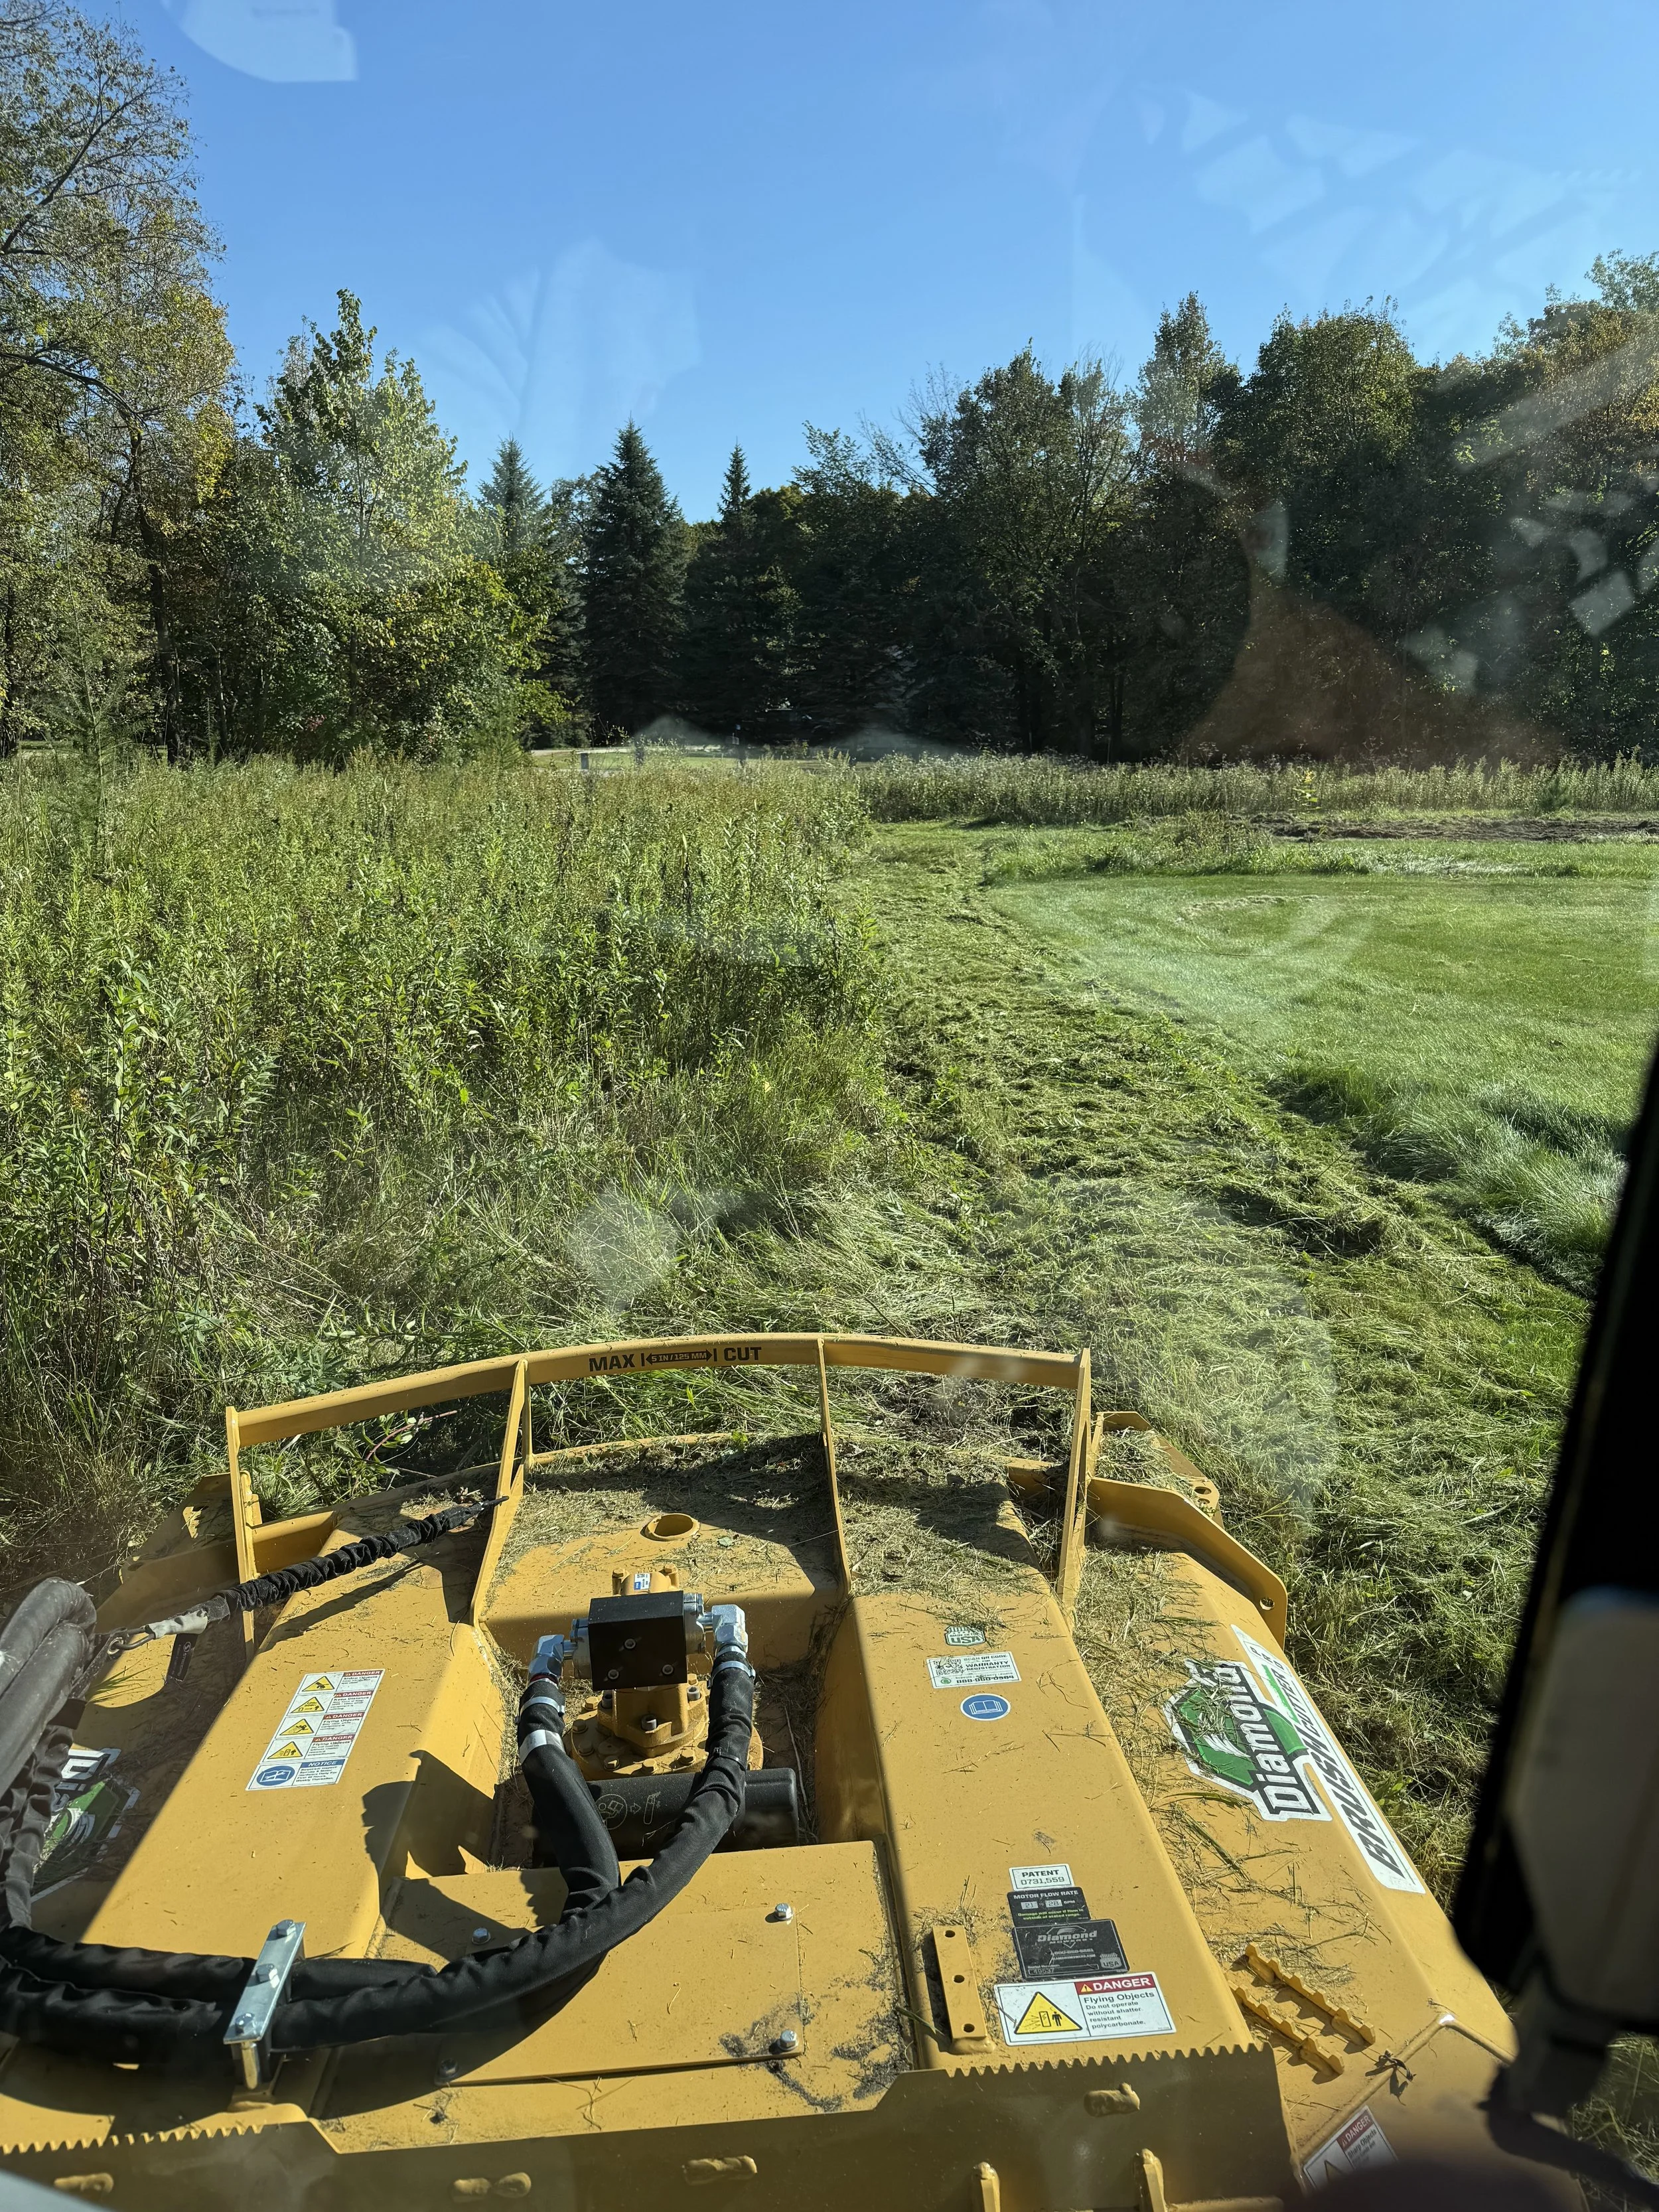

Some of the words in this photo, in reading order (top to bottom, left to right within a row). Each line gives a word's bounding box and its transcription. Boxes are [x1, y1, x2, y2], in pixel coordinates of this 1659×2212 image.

[589, 1353, 636, 1372] MAX
[724, 1347, 762, 1361] CUT
[951, 1635, 981, 1644] USA
[1251, 1646, 1285, 1671] PRO
[1272, 1666, 1322, 1738] CUTTER
[1296, 1724, 1407, 1880] BRUSH
[1037, 1930, 1098, 1943] Diamond
[1093, 1977, 1152, 1991] DANGER
[1083, 1995, 1115, 2004] Flying
[1117, 1992, 1155, 2000] Objects
[1092, 2020, 1146, 2029] polycarbonate.
[1345, 2115, 1371, 2142] DANGER
[1360, 2128, 1377, 2146] Objects
